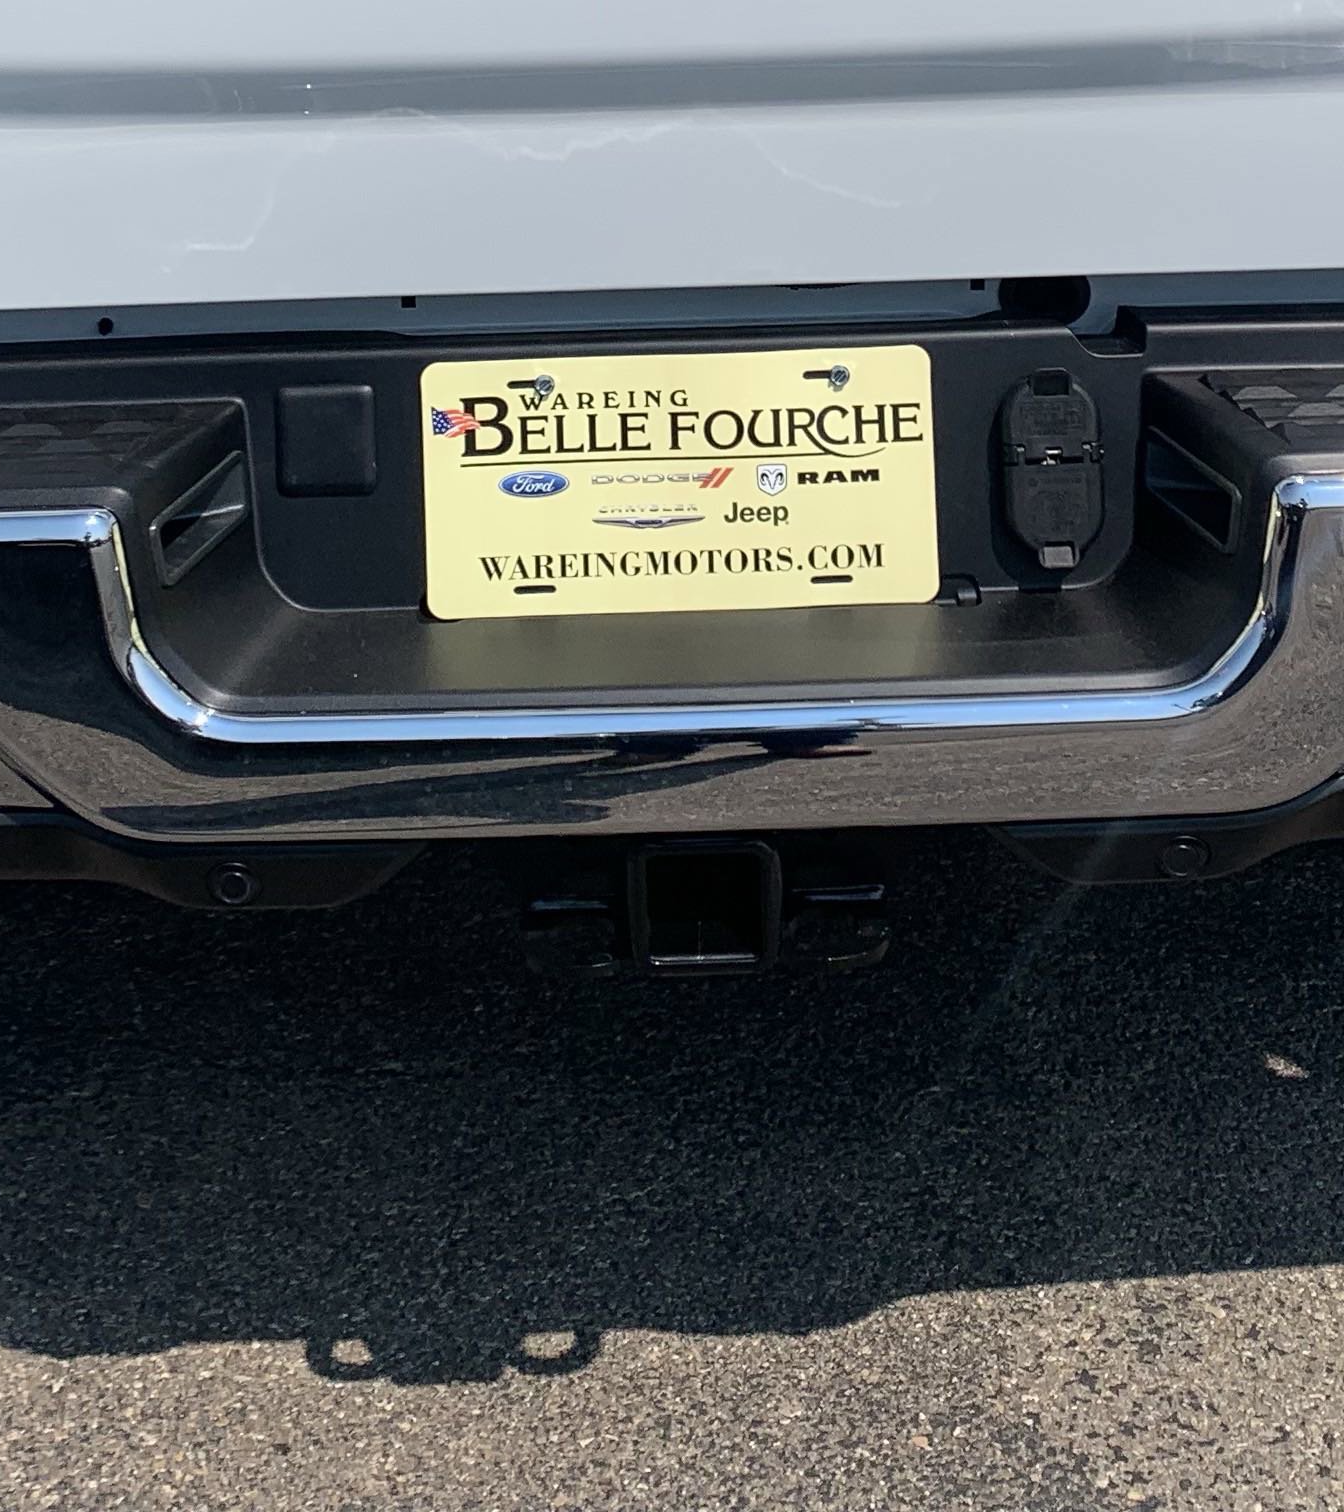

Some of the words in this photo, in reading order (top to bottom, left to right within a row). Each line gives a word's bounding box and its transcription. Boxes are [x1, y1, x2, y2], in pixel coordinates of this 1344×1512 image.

[519, 389, 689, 411] WAREING
[459, 396, 652, 458] BELLE
[670, 402, 924, 457] FOURCHE
[511, 474, 556, 494] Ford
[591, 472, 713, 485] DODGE
[797, 467, 880, 485] RAM
[724, 502, 789, 526] Jeep
[478, 543, 885, 582] WAREINGMOTORS.COM
